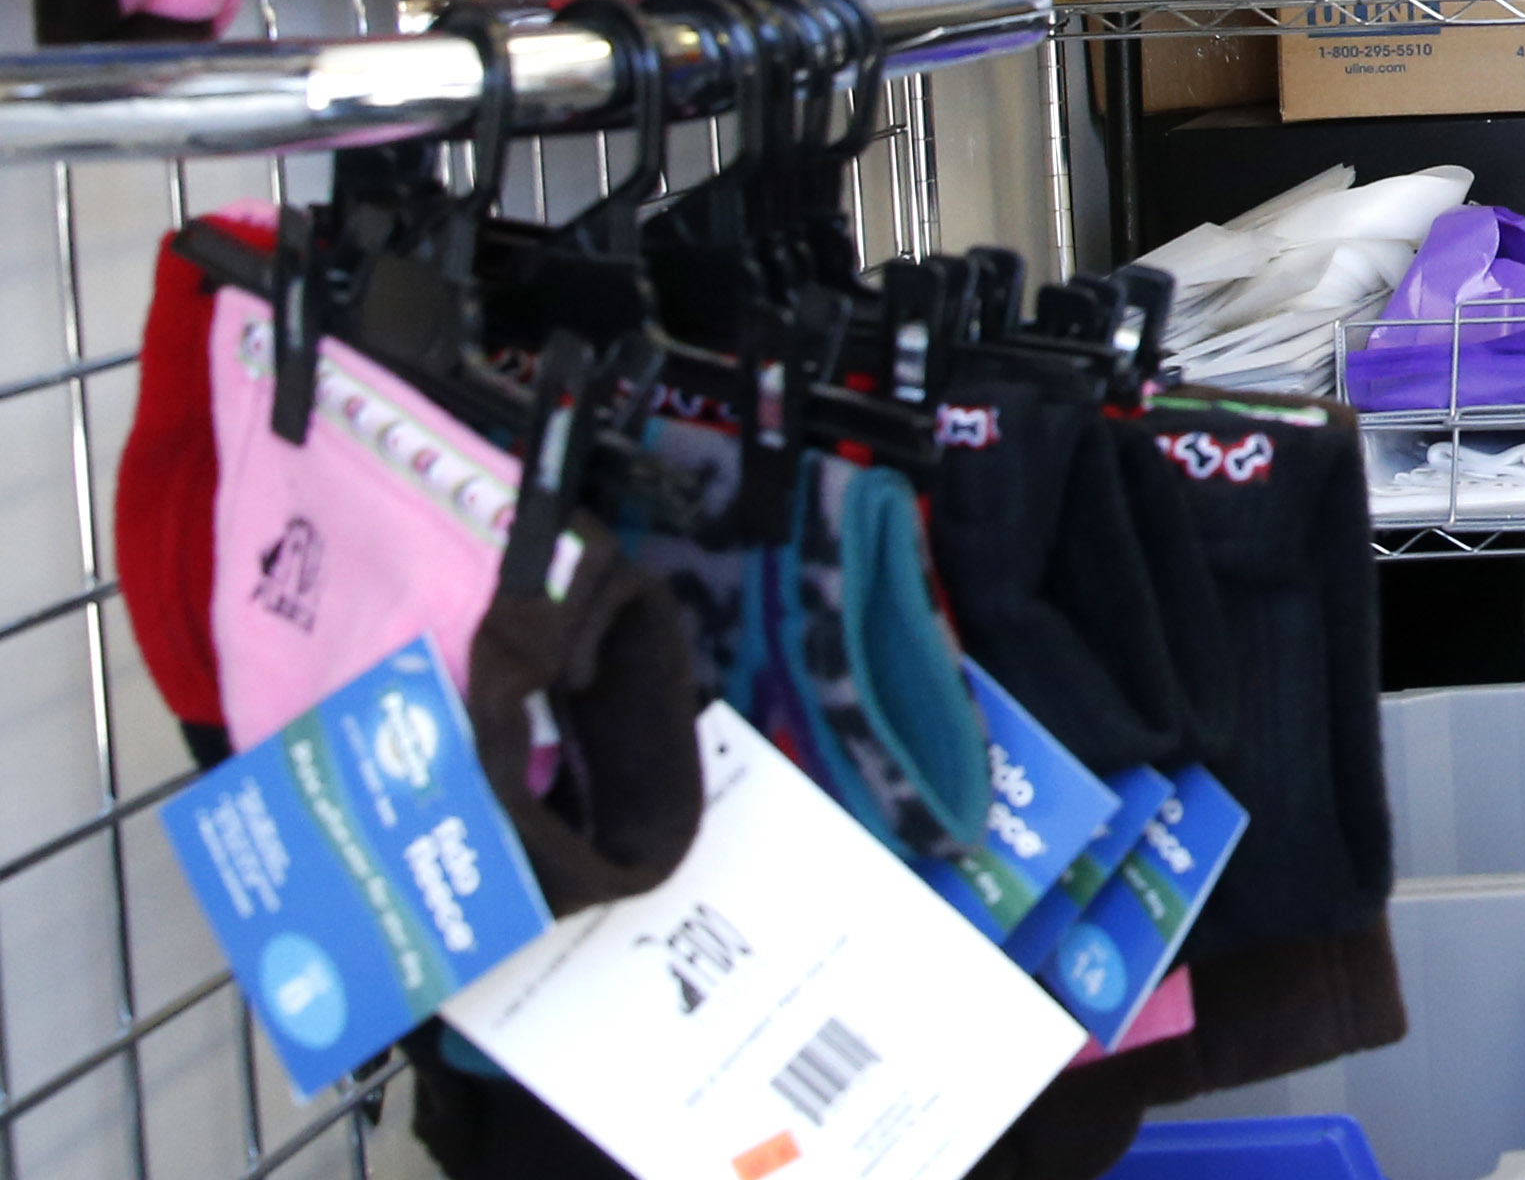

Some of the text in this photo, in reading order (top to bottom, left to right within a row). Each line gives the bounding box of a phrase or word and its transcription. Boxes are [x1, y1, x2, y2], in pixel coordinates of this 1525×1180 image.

[1318, 43, 1433, 59] 1-800-295-5510
[1516, 45, 1525, 58] 4
[1344, 61, 1407, 76] uline.com
[433, 816, 481, 897] fido
[404, 833, 477, 952] fleece
[1070, 952, 1107, 996] 14
